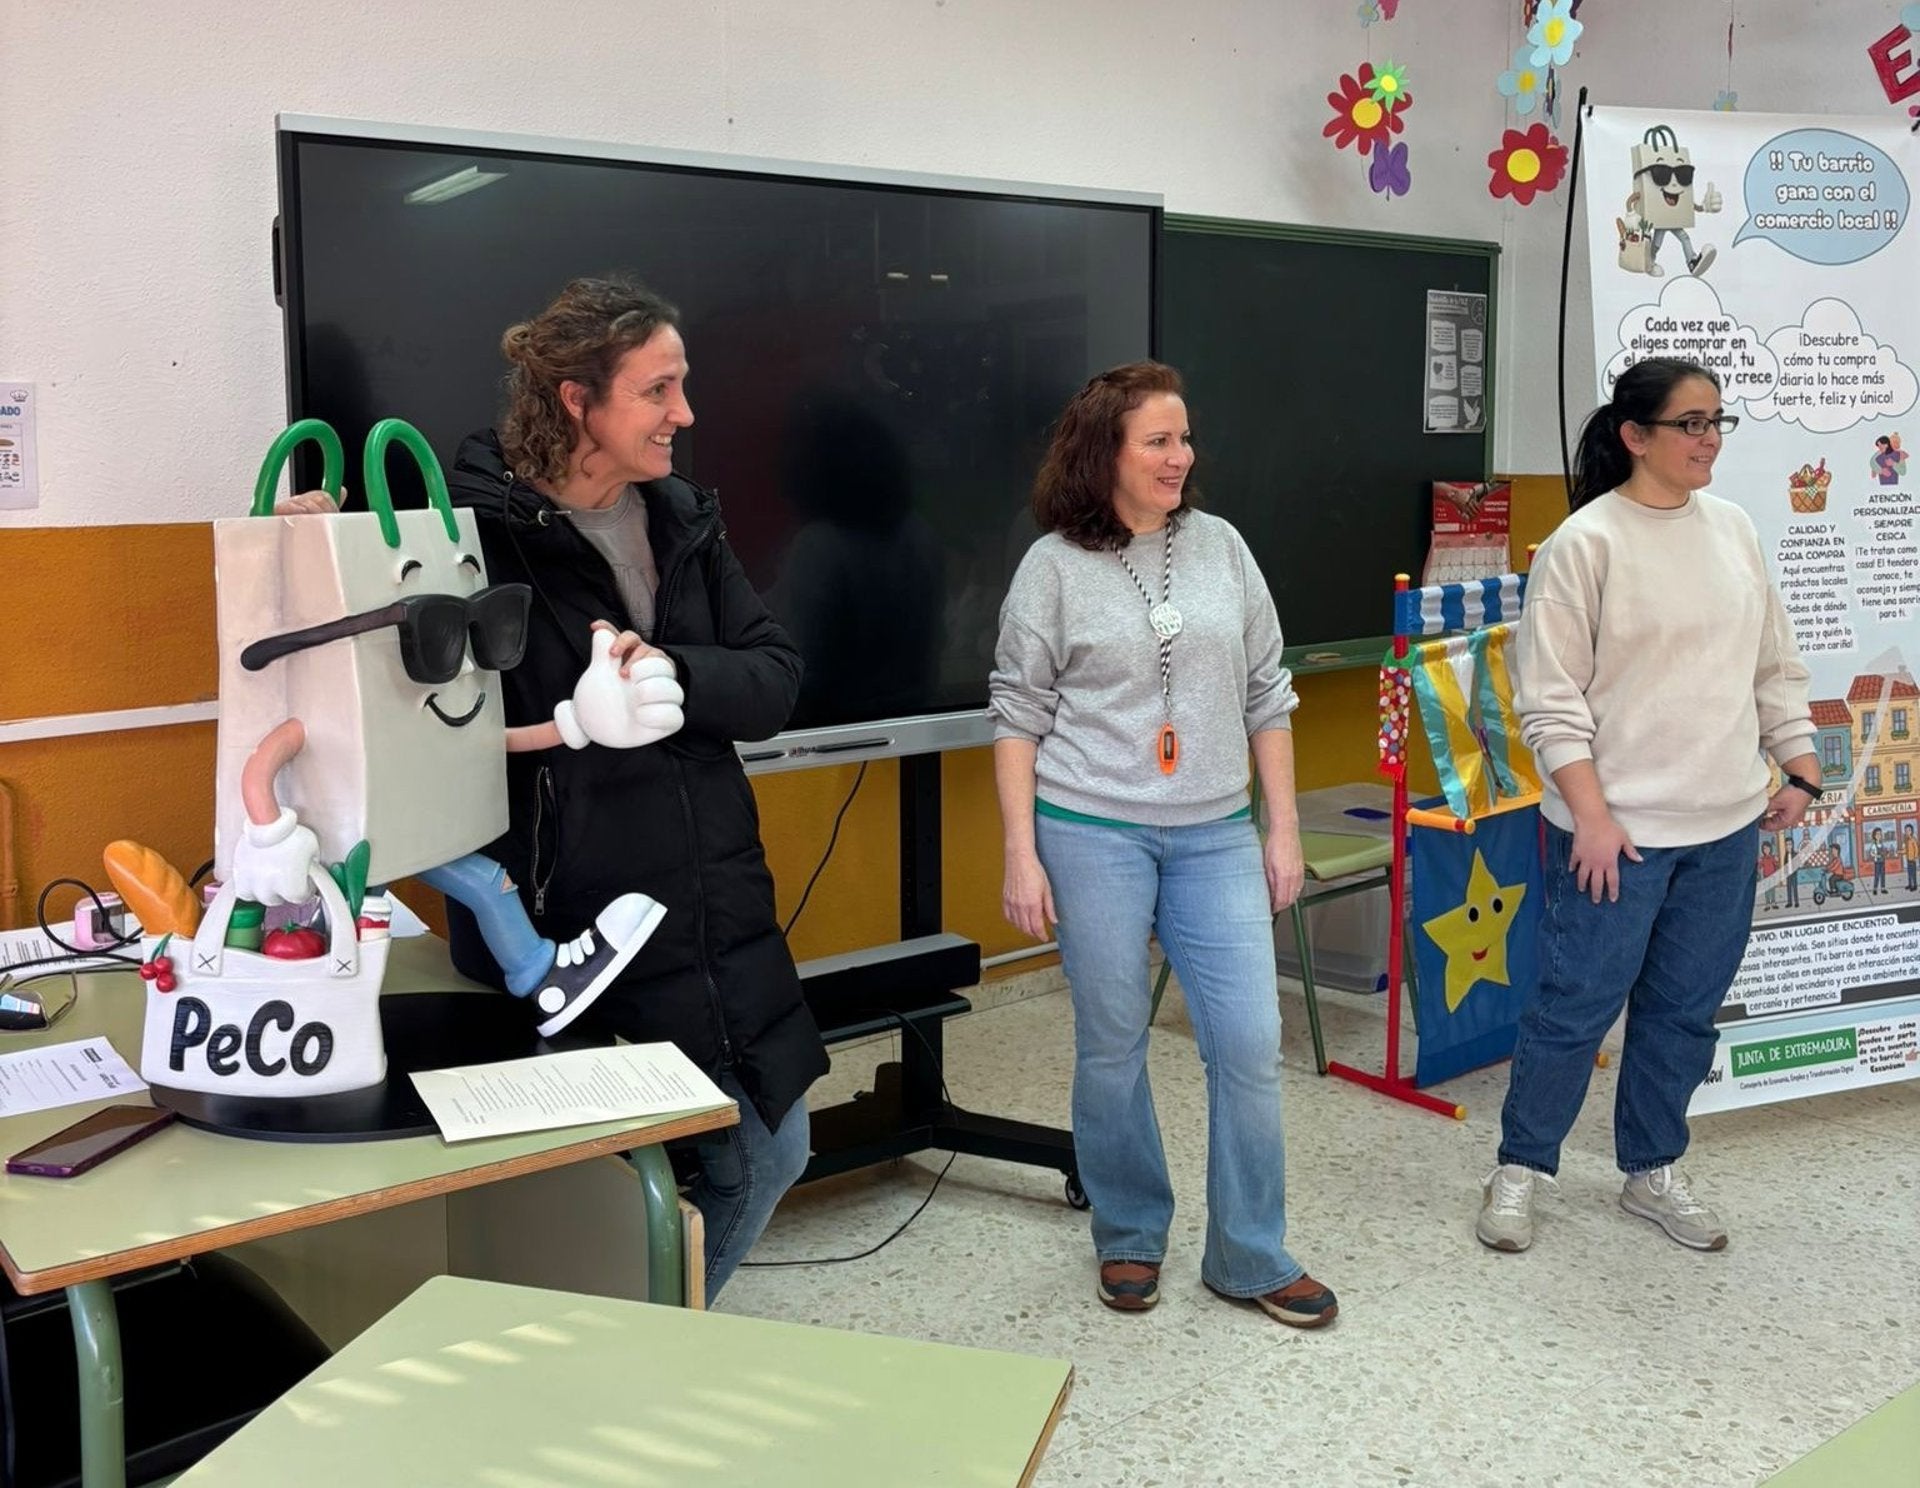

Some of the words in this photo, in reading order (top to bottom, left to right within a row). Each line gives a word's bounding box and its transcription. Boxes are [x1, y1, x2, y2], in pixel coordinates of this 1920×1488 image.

[1769, 151, 1784, 171] !!
[1788, 151, 1813, 172] Tu
[1818, 151, 1874, 173] barrio
[1776, 183, 1818, 205] gana
[1823, 185, 1855, 201] con
[1859, 181, 1876, 202] el
[1755, 209, 1834, 229] comercio
[1838, 209, 1880, 229] local
[1884, 209, 1898, 229] !!
[1645, 317, 1677, 332] Cada
[1681, 320, 1703, 332] vez
[1707, 320, 1730, 336] que
[1631, 334, 1669, 353] eliges
[1673, 337, 1726, 352] comprar
[1731, 337, 1746, 349] en
[1800, 332, 1859, 347] ¡Descubre
[1624, 352, 1635, 367] el
[1703, 351, 1737, 368] local,
[1740, 354, 1755, 367] tu
[1784, 352, 1813, 366] cómo
[1817, 352, 1829, 365] tu
[1834, 355, 1876, 368] compra
[1723, 372, 1731, 388] y
[1735, 371, 1772, 384] crece
[1780, 372, 1813, 386] diaria
[1817, 372, 1828, 385] lo
[1831, 372, 1859, 385] hace
[1862, 371, 1885, 384] más
[1773, 391, 1816, 407] fuerte,
[1820, 391, 1846, 405] feliz
[1849, 395, 1856, 408] y
[1860, 390, 1893, 404] único!
[1869, 492, 1912, 503] ATENCIÓN
[1853, 505, 1920, 516] PERSONALIZAD
[1788, 524, 1827, 534] CALIDAD
[1829, 524, 1836, 533] Y
[1876, 531, 1906, 541] CERCA
[1780, 537, 1831, 548] CONFIANZA
[1833, 537, 1845, 545] EN
[1777, 551, 1803, 561] CADA
[1805, 549, 1845, 559] COMPRA
[1897, 546, 1917, 554] como
[1877, 558, 1885, 568] El
[1887, 557, 1919, 567] tendero
[1783, 565, 1800, 577] Aquí
[1802, 563, 1845, 574] encuentras
[1904, 570, 1913, 579] te
[1780, 577, 1820, 589] productos
[1822, 576, 1848, 586] locales
[1856, 583, 1891, 595] aconseja
[1892, 586, 1897, 594] y
[1790, 591, 1800, 600] de
[1862, 597, 1881, 607] tiene
[1812, 602, 1822, 612] de
[1824, 601, 1847, 611] dónde
[1793, 616, 1814, 626] viene
[1815, 615, 1823, 625] lo
[1825, 616, 1839, 626] que
[1879, 610, 1897, 621] para
[1815, 631, 1821, 640] y
[1822, 626, 1843, 639] quién
[1844, 626, 1852, 636] lo
[1812, 643, 1826, 651] con
[1827, 639, 1853, 650] cariño!
[1780, 930, 1792, 940] UN
[1795, 925, 1825, 938] LUGAR
[1827, 923, 1840, 933] DE
[1842, 916, 1895, 931] ENCUENTRO
[1747, 947, 1766, 958] calle
[1768, 946, 1789, 956] tenga
[1811, 939, 1826, 950] Son
[1828, 937, 1849, 948] sitios
[1850, 932, 1874, 944] donde
[1875, 932, 1884, 941] te
[1829, 949, 1853, 960] barrio
[1855, 948, 1863, 957] es
[1865, 945, 1880, 954] más
[1882, 939, 1918, 953] divertido!
[1764, 973, 1775, 982] las
[1777, 969, 1799, 980] calles
[1801, 969, 1811, 977] en
[1812, 963, 1844, 977] espacios
[1846, 962, 1856, 971] de
[1858, 956, 1900, 969] interacción
[1733, 990, 1741, 999] la
[1742, 986, 1779, 999] identidad
[1781, 982, 1793, 992] del
[1795, 978, 1834, 990] vecindario
[1836, 979, 1841, 988] y
[1843, 974, 1860, 984] crea
[1862, 973, 1871, 981] un
[1872, 968, 1907, 980] ambiente
[1909, 966, 1918, 975] de
[1749, 997, 1782, 1010] cercanía
[1784, 999, 1789, 1008] y
[169, 996, 334, 1077] PeCo
[1737, 1049, 1766, 1069] JUNTA
[1769, 1046, 1781, 1062] DE
[1785, 1036, 1852, 1060] EXTREMADURA
